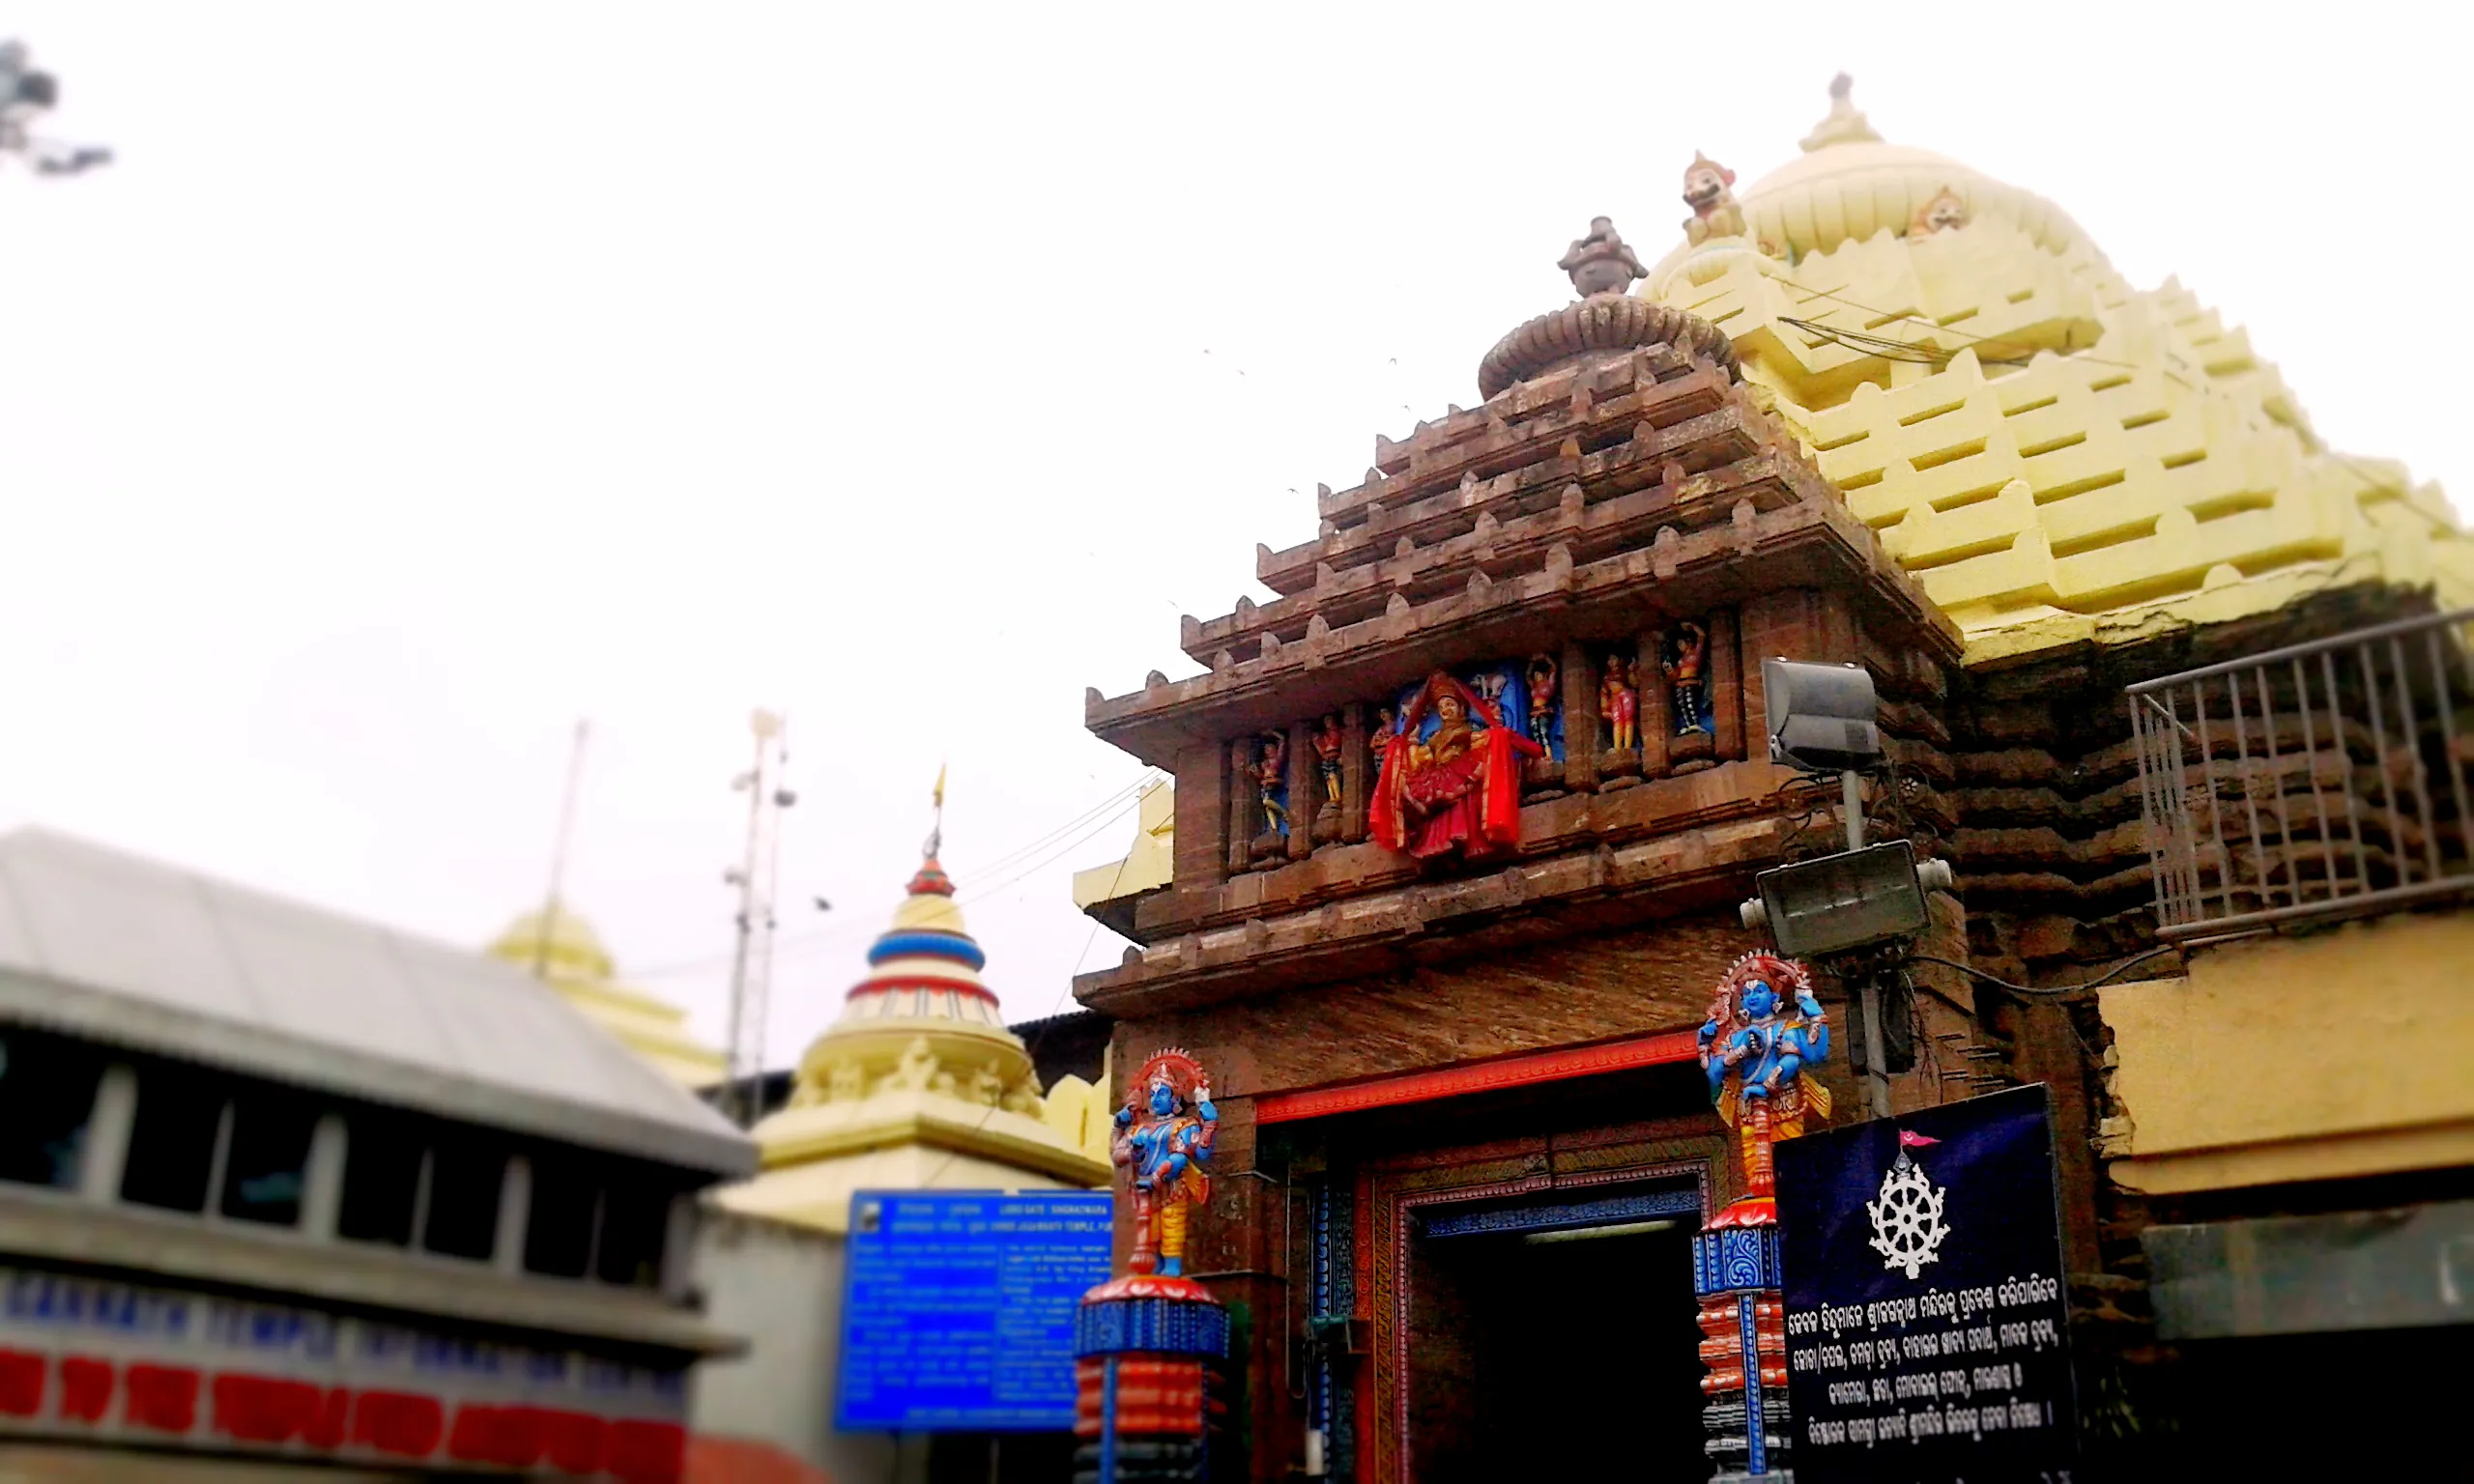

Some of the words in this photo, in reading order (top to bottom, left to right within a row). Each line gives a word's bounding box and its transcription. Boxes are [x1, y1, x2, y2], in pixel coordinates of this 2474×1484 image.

[1788, 1310, 1818, 1335] କେବଳ
[1821, 1301, 1863, 1340] ହିନ୍ଦୁମାନେ
[1959, 1286, 1995, 1320] ପ୍ରବେଶ
[1998, 1272, 2057, 1307] କରିପାରିବେ
